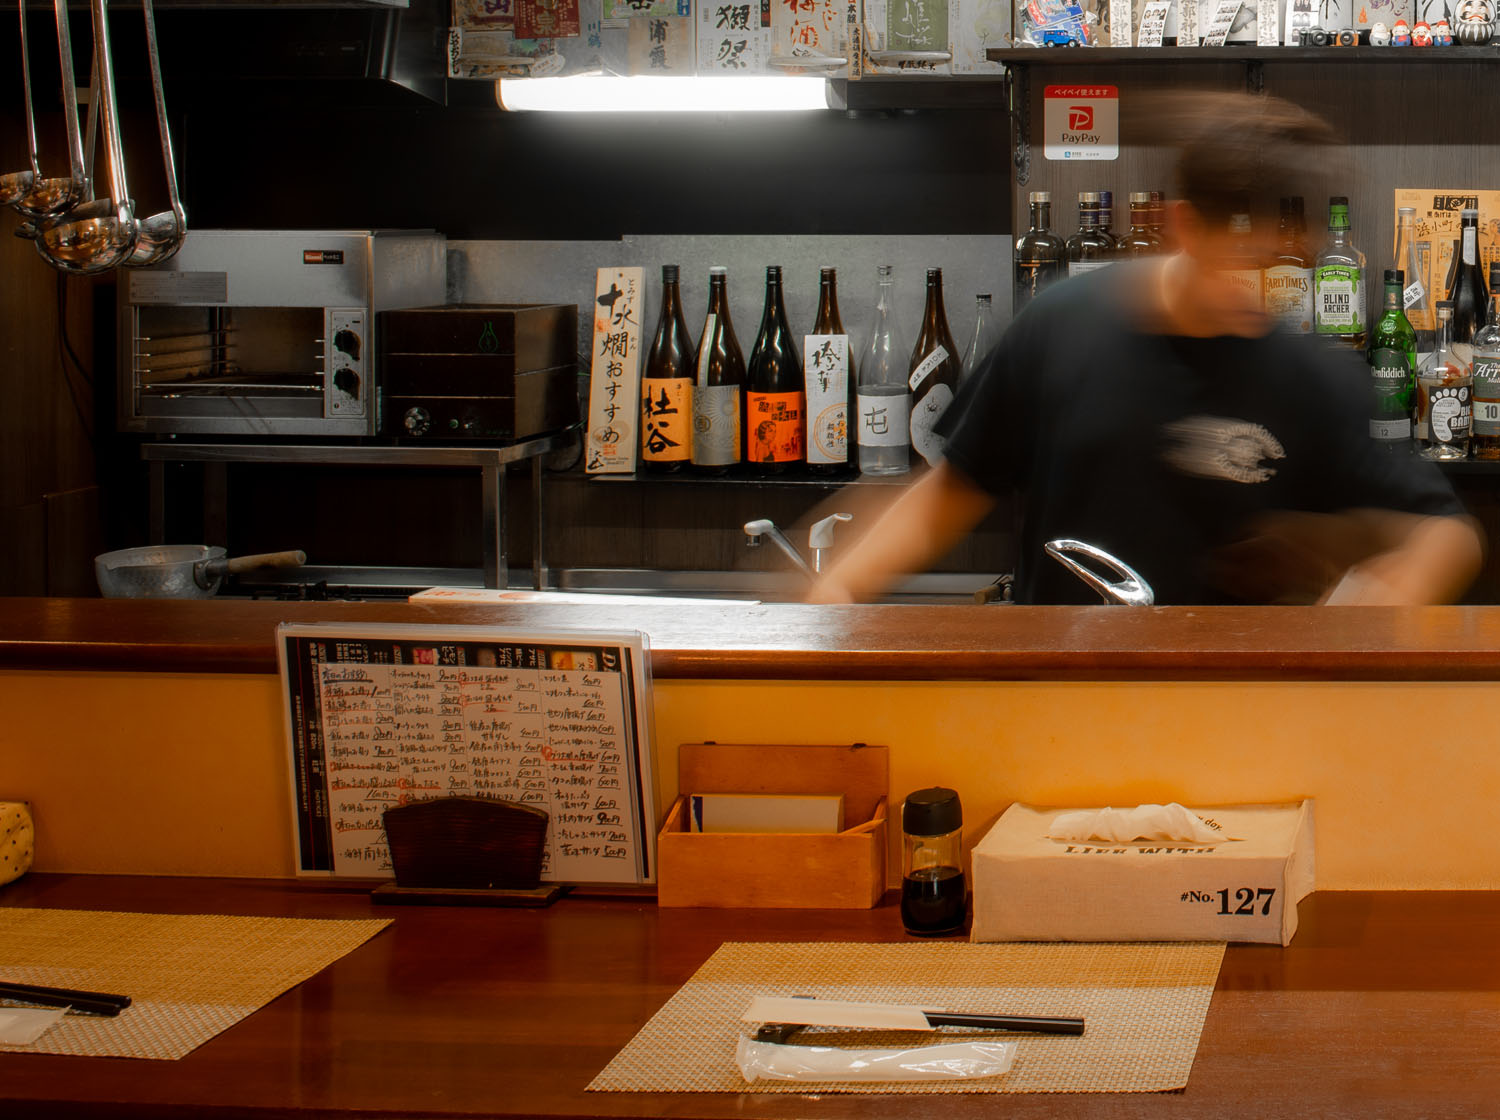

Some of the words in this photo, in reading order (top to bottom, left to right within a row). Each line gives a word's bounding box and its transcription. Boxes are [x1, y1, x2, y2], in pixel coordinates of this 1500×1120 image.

[715, 4, 752, 70] 獺祭
[1053, 88, 1110, 97] ペイペイ使えます
[1061, 132, 1101, 145] PayPay
[1265, 276, 1286, 294] EARLY
[1285, 275, 1309, 293] TIMES
[1323, 293, 1350, 304] BLIND
[1323, 304, 1350, 314] ARCHER
[596, 283, 640, 444] 十水燗おすすめ
[1484, 404, 1498, 420] 10
[1380, 428, 1389, 437] 12
[1203, 816, 1223, 832] day.
[1180, 890, 1215, 904] #No.
[1215, 886, 1277, 916] 127
